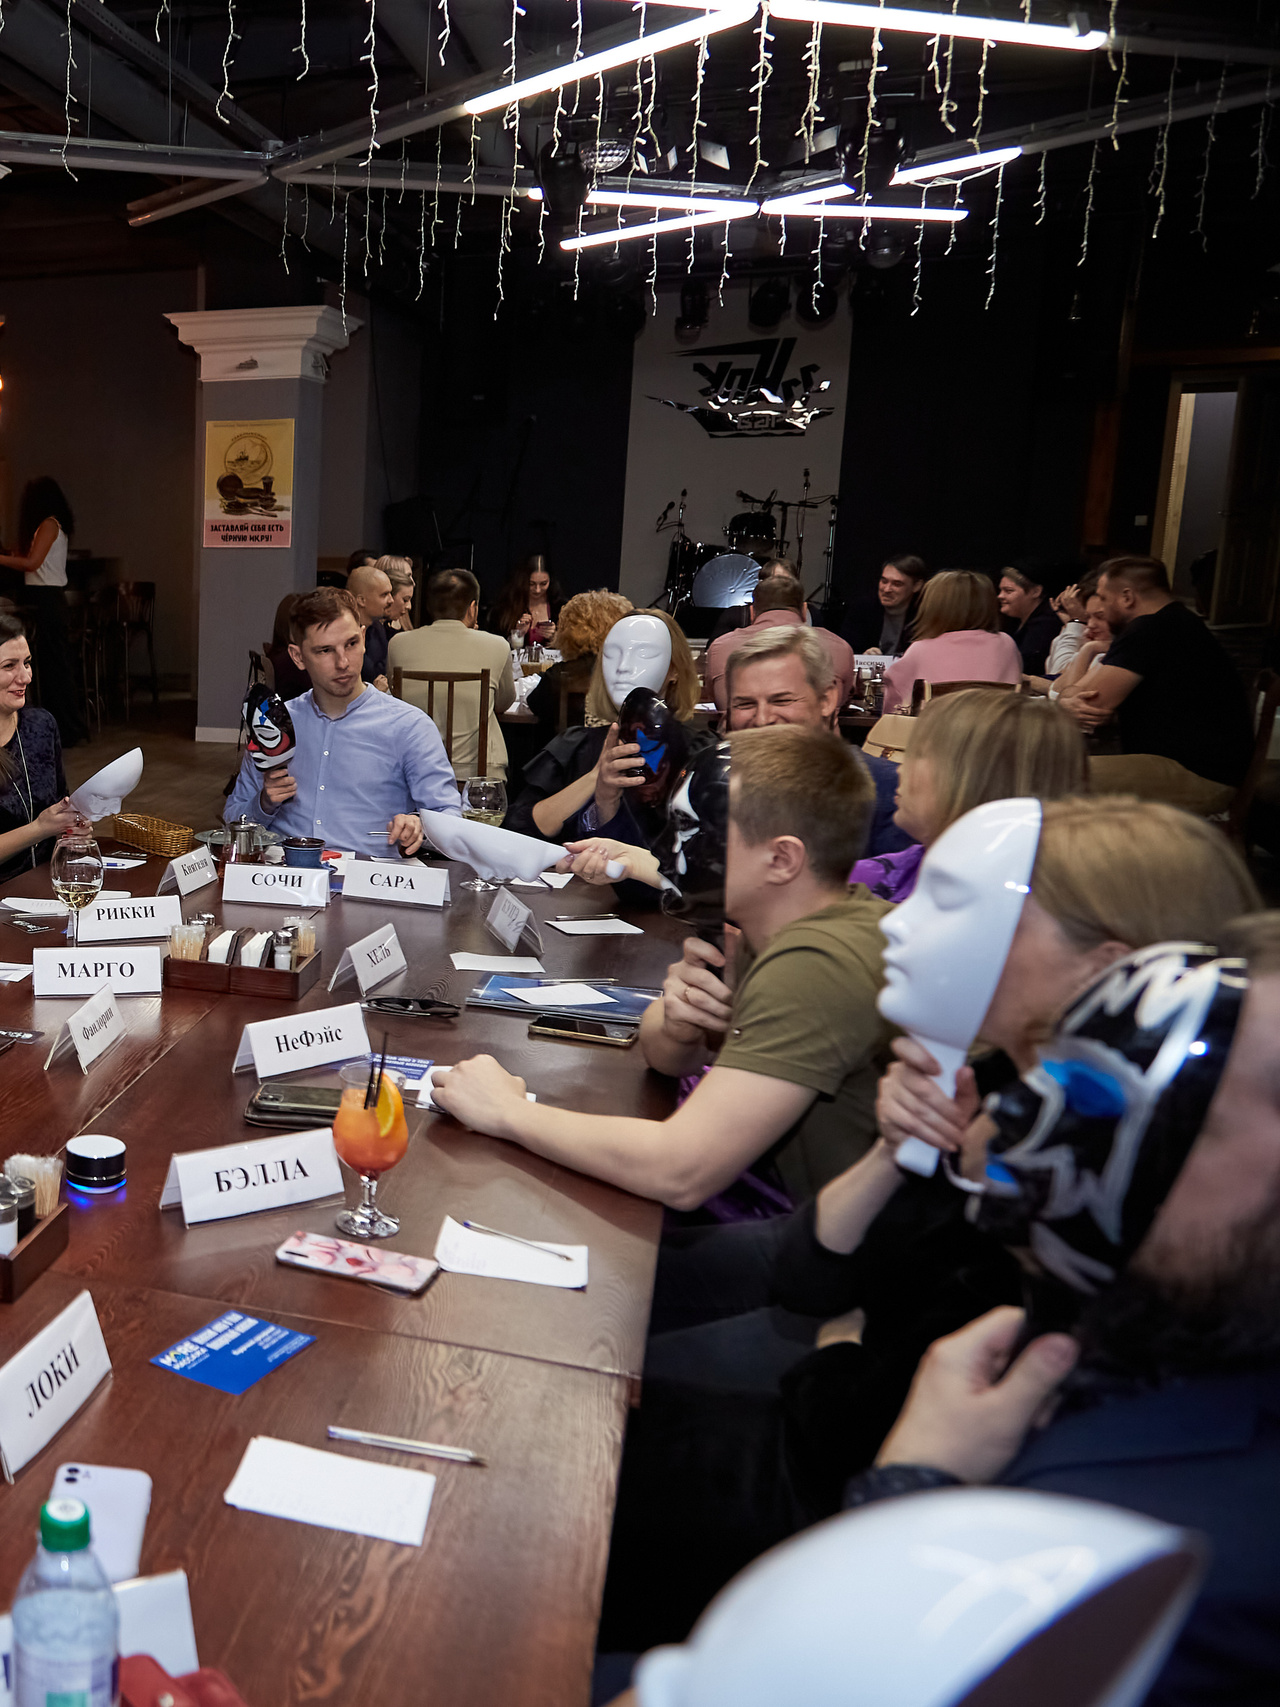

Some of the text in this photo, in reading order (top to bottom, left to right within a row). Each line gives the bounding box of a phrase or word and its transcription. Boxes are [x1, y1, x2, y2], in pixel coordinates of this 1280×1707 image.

[210, 523, 284, 532] ЗАСТАВЛЯЙ СЕБЯ ЕСТЬ
[221, 533, 273, 542] ЧЁРНУЮ ИКРУ!
[251, 873, 304, 889] СОЧИ
[369, 873, 417, 891] САРА
[96, 905, 157, 922] РИККИ
[366, 943, 392, 968] ХЕЛЬ
[58, 962, 135, 978] МАРГО
[82, 1007, 115, 1041] Фандорин
[275, 1026, 343, 1053] НеФэйс
[215, 1157, 309, 1193] БЭЛЛА
[27, 1342, 80, 1418] ЛОКИ
